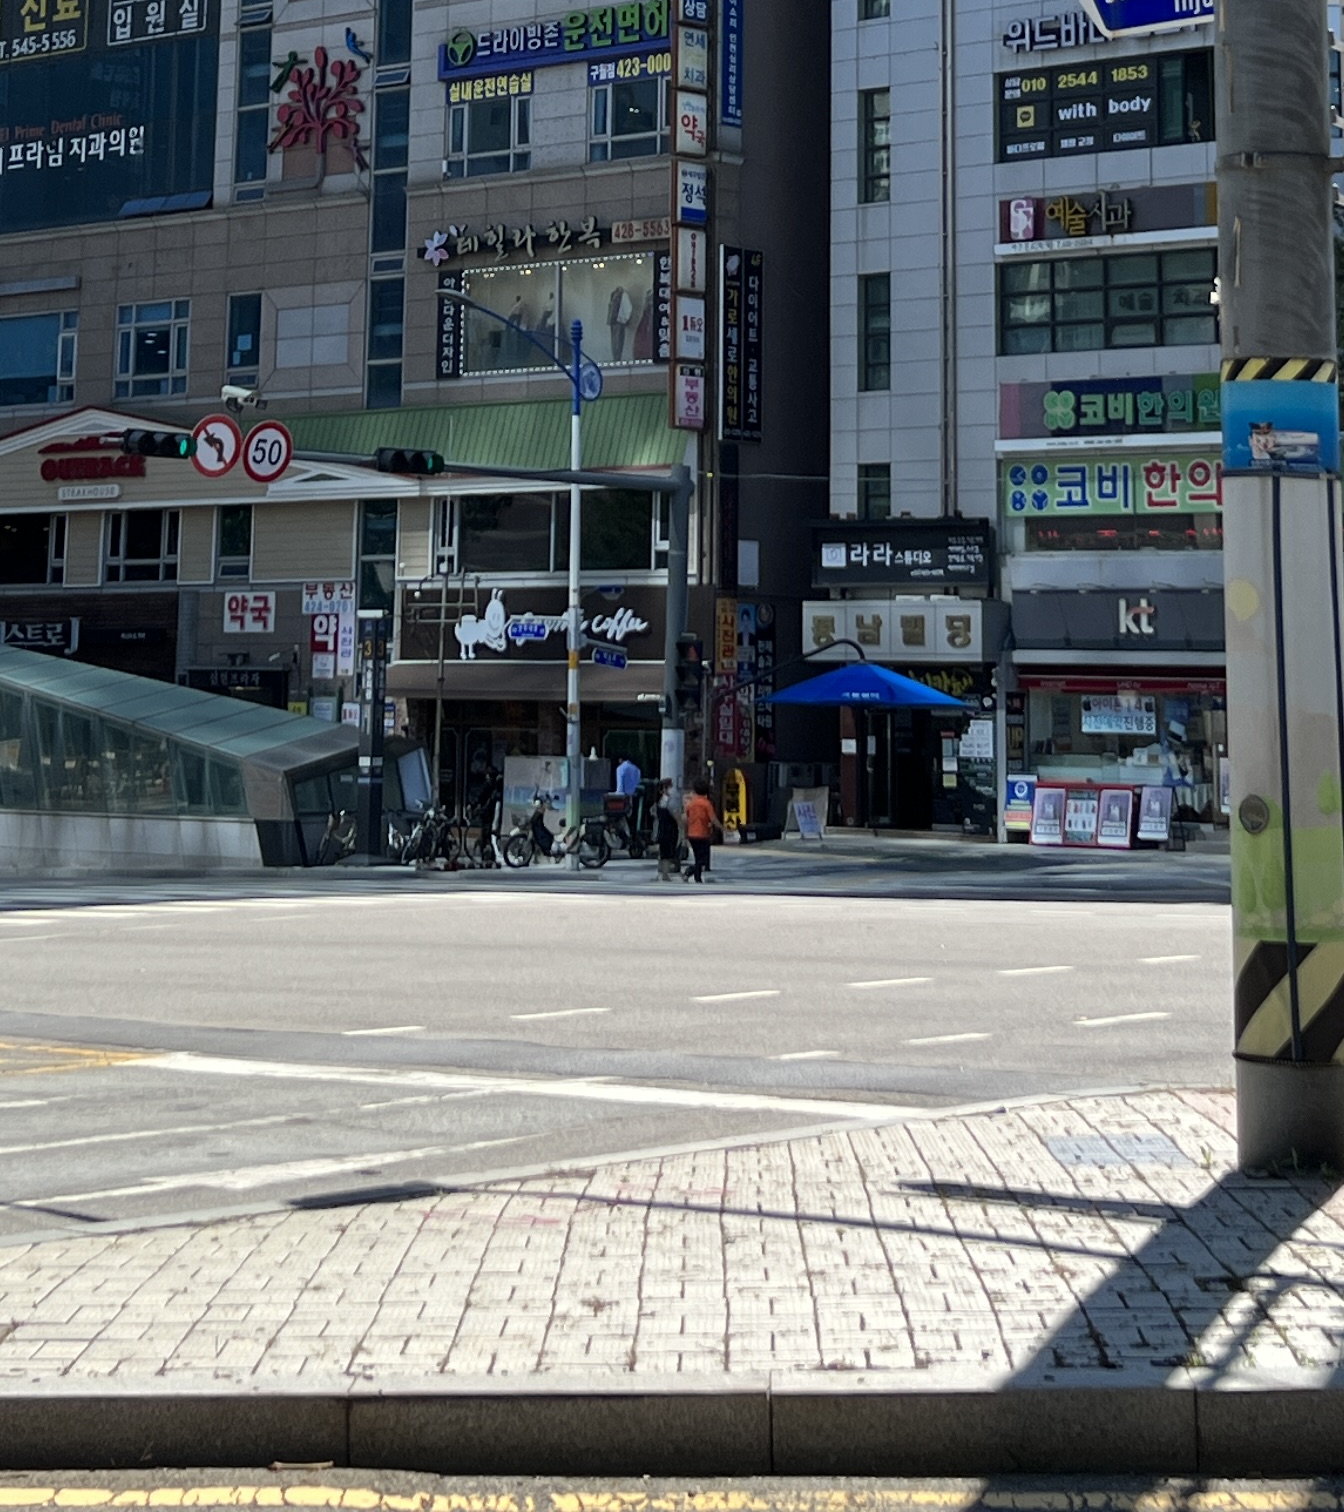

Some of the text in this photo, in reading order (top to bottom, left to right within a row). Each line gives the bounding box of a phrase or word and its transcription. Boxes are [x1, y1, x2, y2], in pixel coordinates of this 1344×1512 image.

[685, 0, 707, 19] 상담
[476, 22, 560, 57] 드라이빙존
[617, 53, 671, 77] 423-000
[1021, 65, 1148, 92] 010 2544 1853
[450, 73, 532, 102] 실내운전연습실
[1058, 95, 1151, 120] with body
[1045, 189, 1132, 236] 예술사과
[547, 216, 602, 254] 한복
[252, 438, 282, 466] 50
[61, 487, 115, 498] STEAKHOUSE
[1055, 464, 1131, 509] 코비
[850, 541, 893, 567] 라라
[894, 550, 932, 565] 스튜디오
[305, 582, 353, 599] 부동산
[228, 594, 272, 630] 약국
[1118, 598, 1155, 634] kt
[313, 614, 336, 651] 약
[364, 641, 372, 657] 3
[1123, 714, 1154, 730] 진행중
